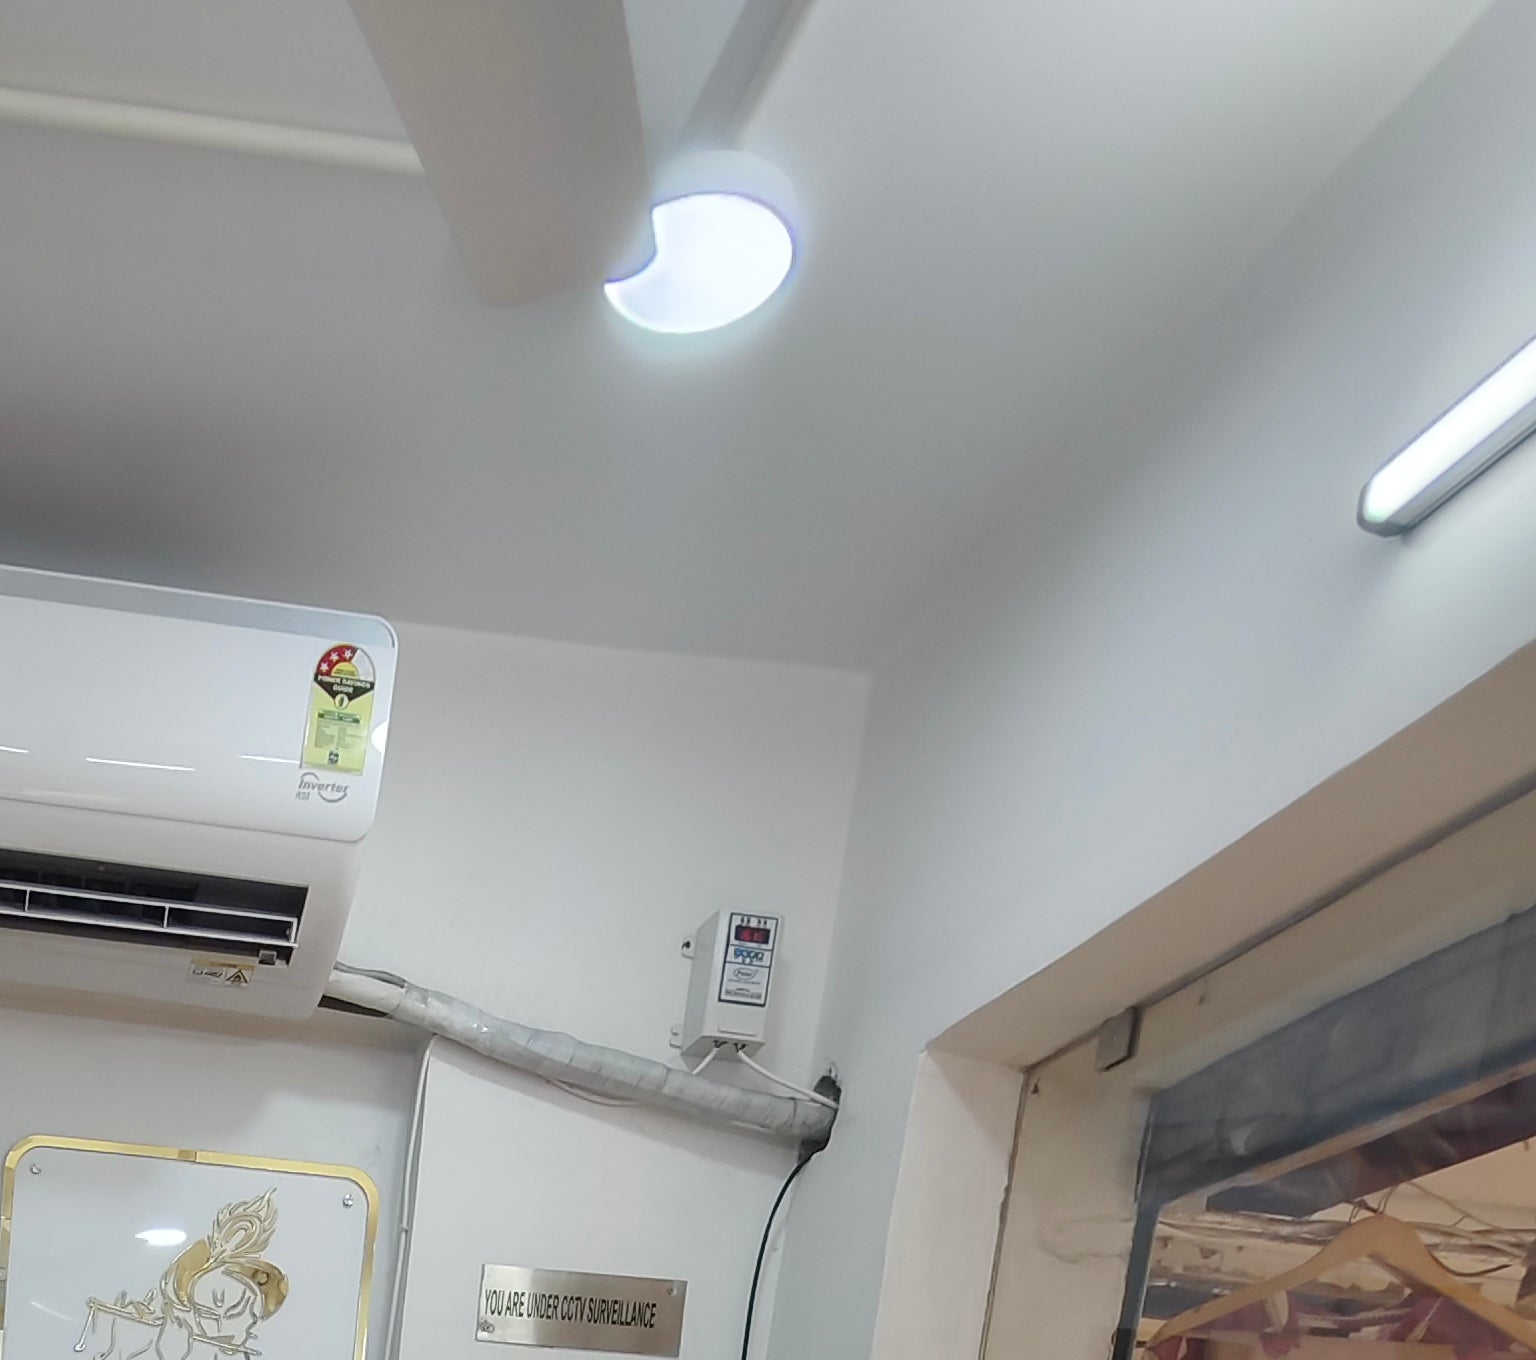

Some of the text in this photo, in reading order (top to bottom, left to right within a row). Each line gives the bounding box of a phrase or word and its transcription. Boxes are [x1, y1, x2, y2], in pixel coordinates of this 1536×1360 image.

[484, 1288, 657, 1328] YOU ARE UNDER CCTV SURVEILLANCE
